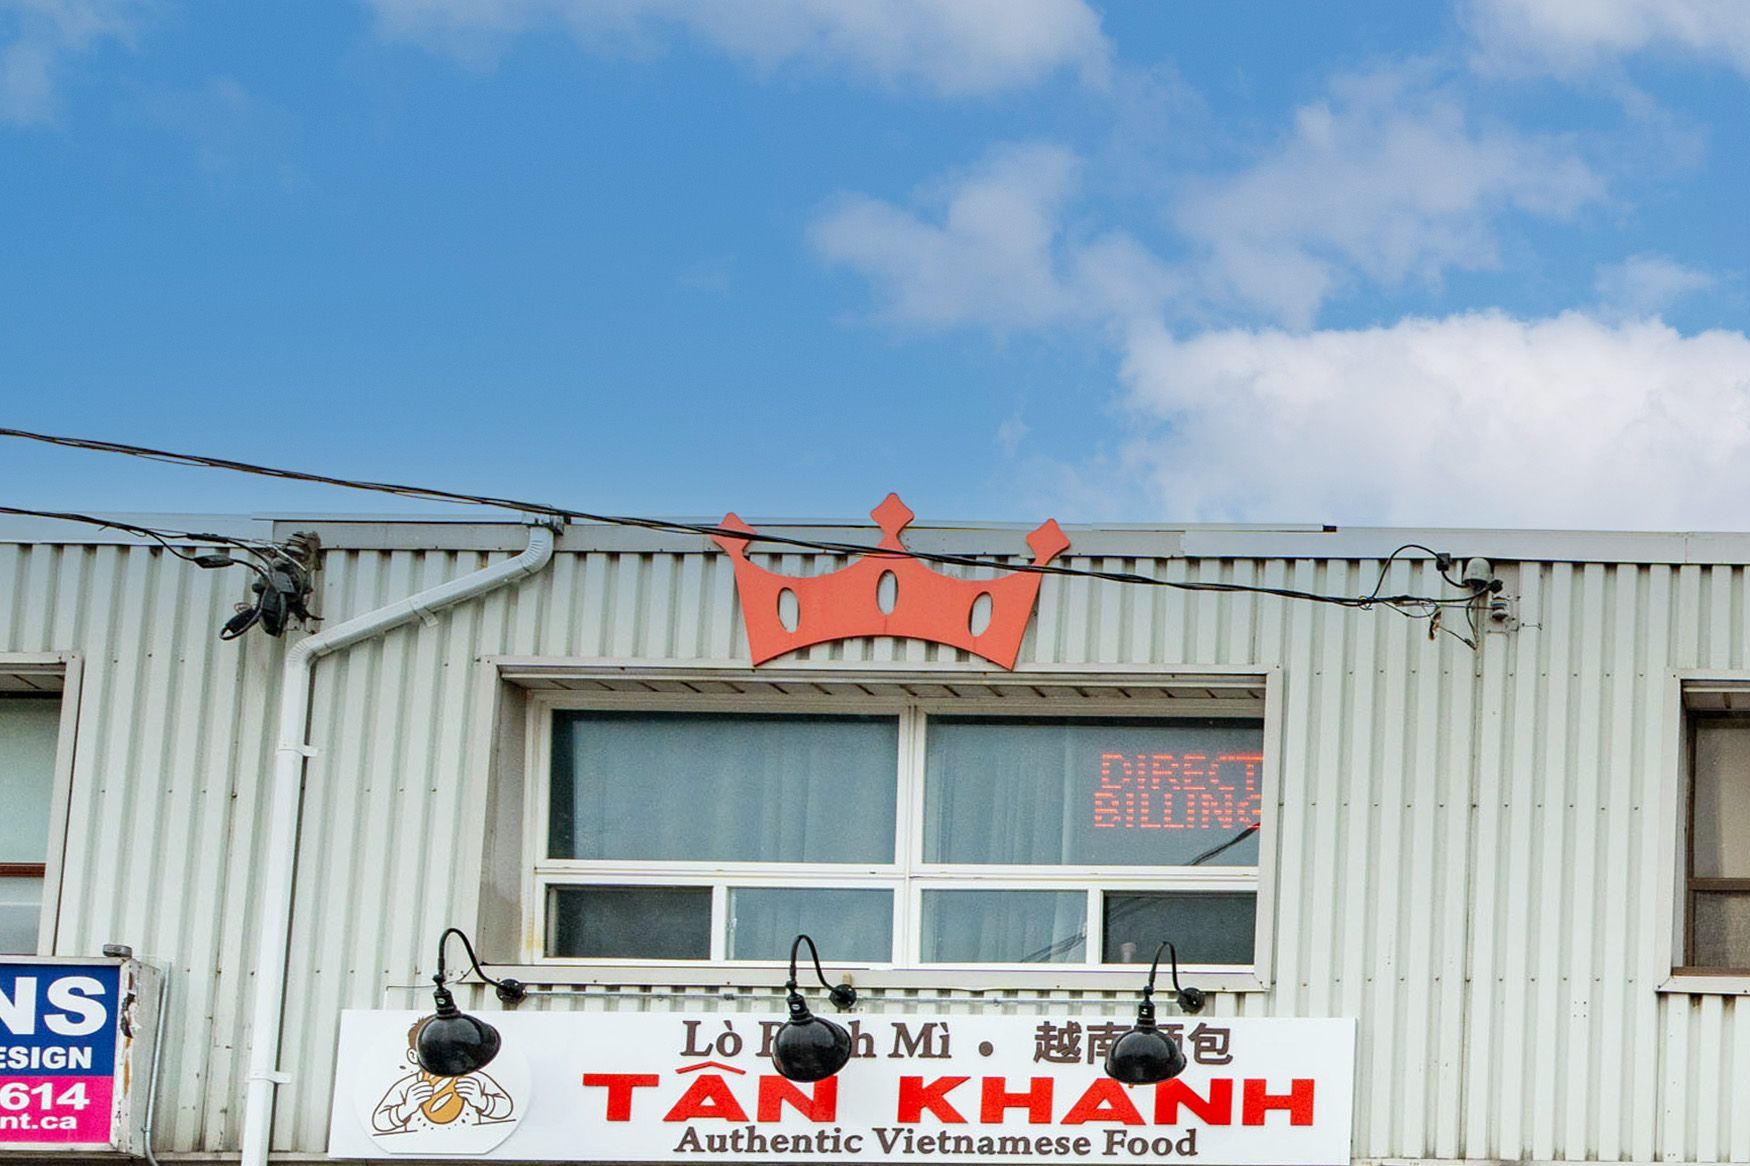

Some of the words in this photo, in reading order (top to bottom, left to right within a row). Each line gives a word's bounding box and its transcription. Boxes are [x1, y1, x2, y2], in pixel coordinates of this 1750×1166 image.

[1102, 754, 1264, 791] DIRECT
[1094, 792, 1262, 829] BILLING
[680, 1020, 743, 1058] Lò
[887, 1021, 953, 1059] Mì
[583, 1060, 839, 1123] TÂN
[674, 1125, 864, 1155] Authentic
[871, 1127, 1092, 1156] Vietnamese
[1101, 1128, 1199, 1157] Food
